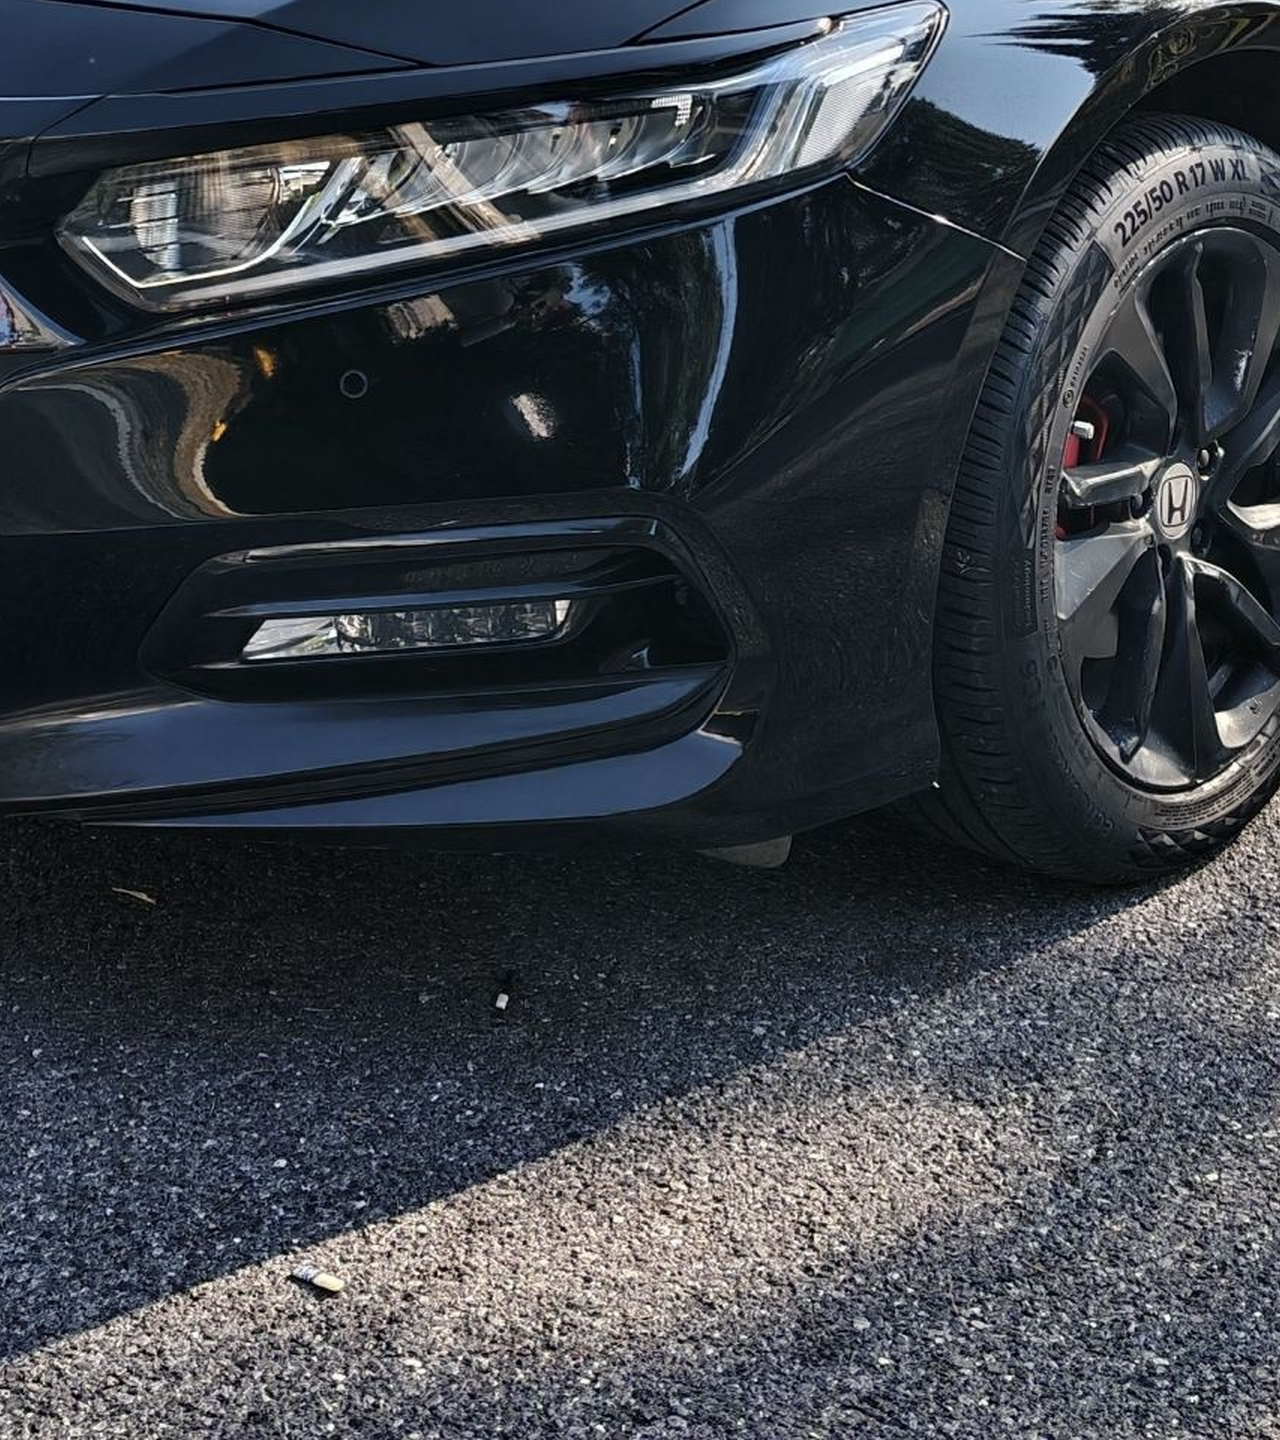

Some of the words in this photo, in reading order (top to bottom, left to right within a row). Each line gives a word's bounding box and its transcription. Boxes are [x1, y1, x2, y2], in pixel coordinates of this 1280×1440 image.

[1113, 179, 1174, 248] 225/50
[1173, 170, 1190, 195] R
[1188, 161, 1207, 188] 17
[1209, 158, 1226, 182] W
[1231, 158, 1252, 181] XL
